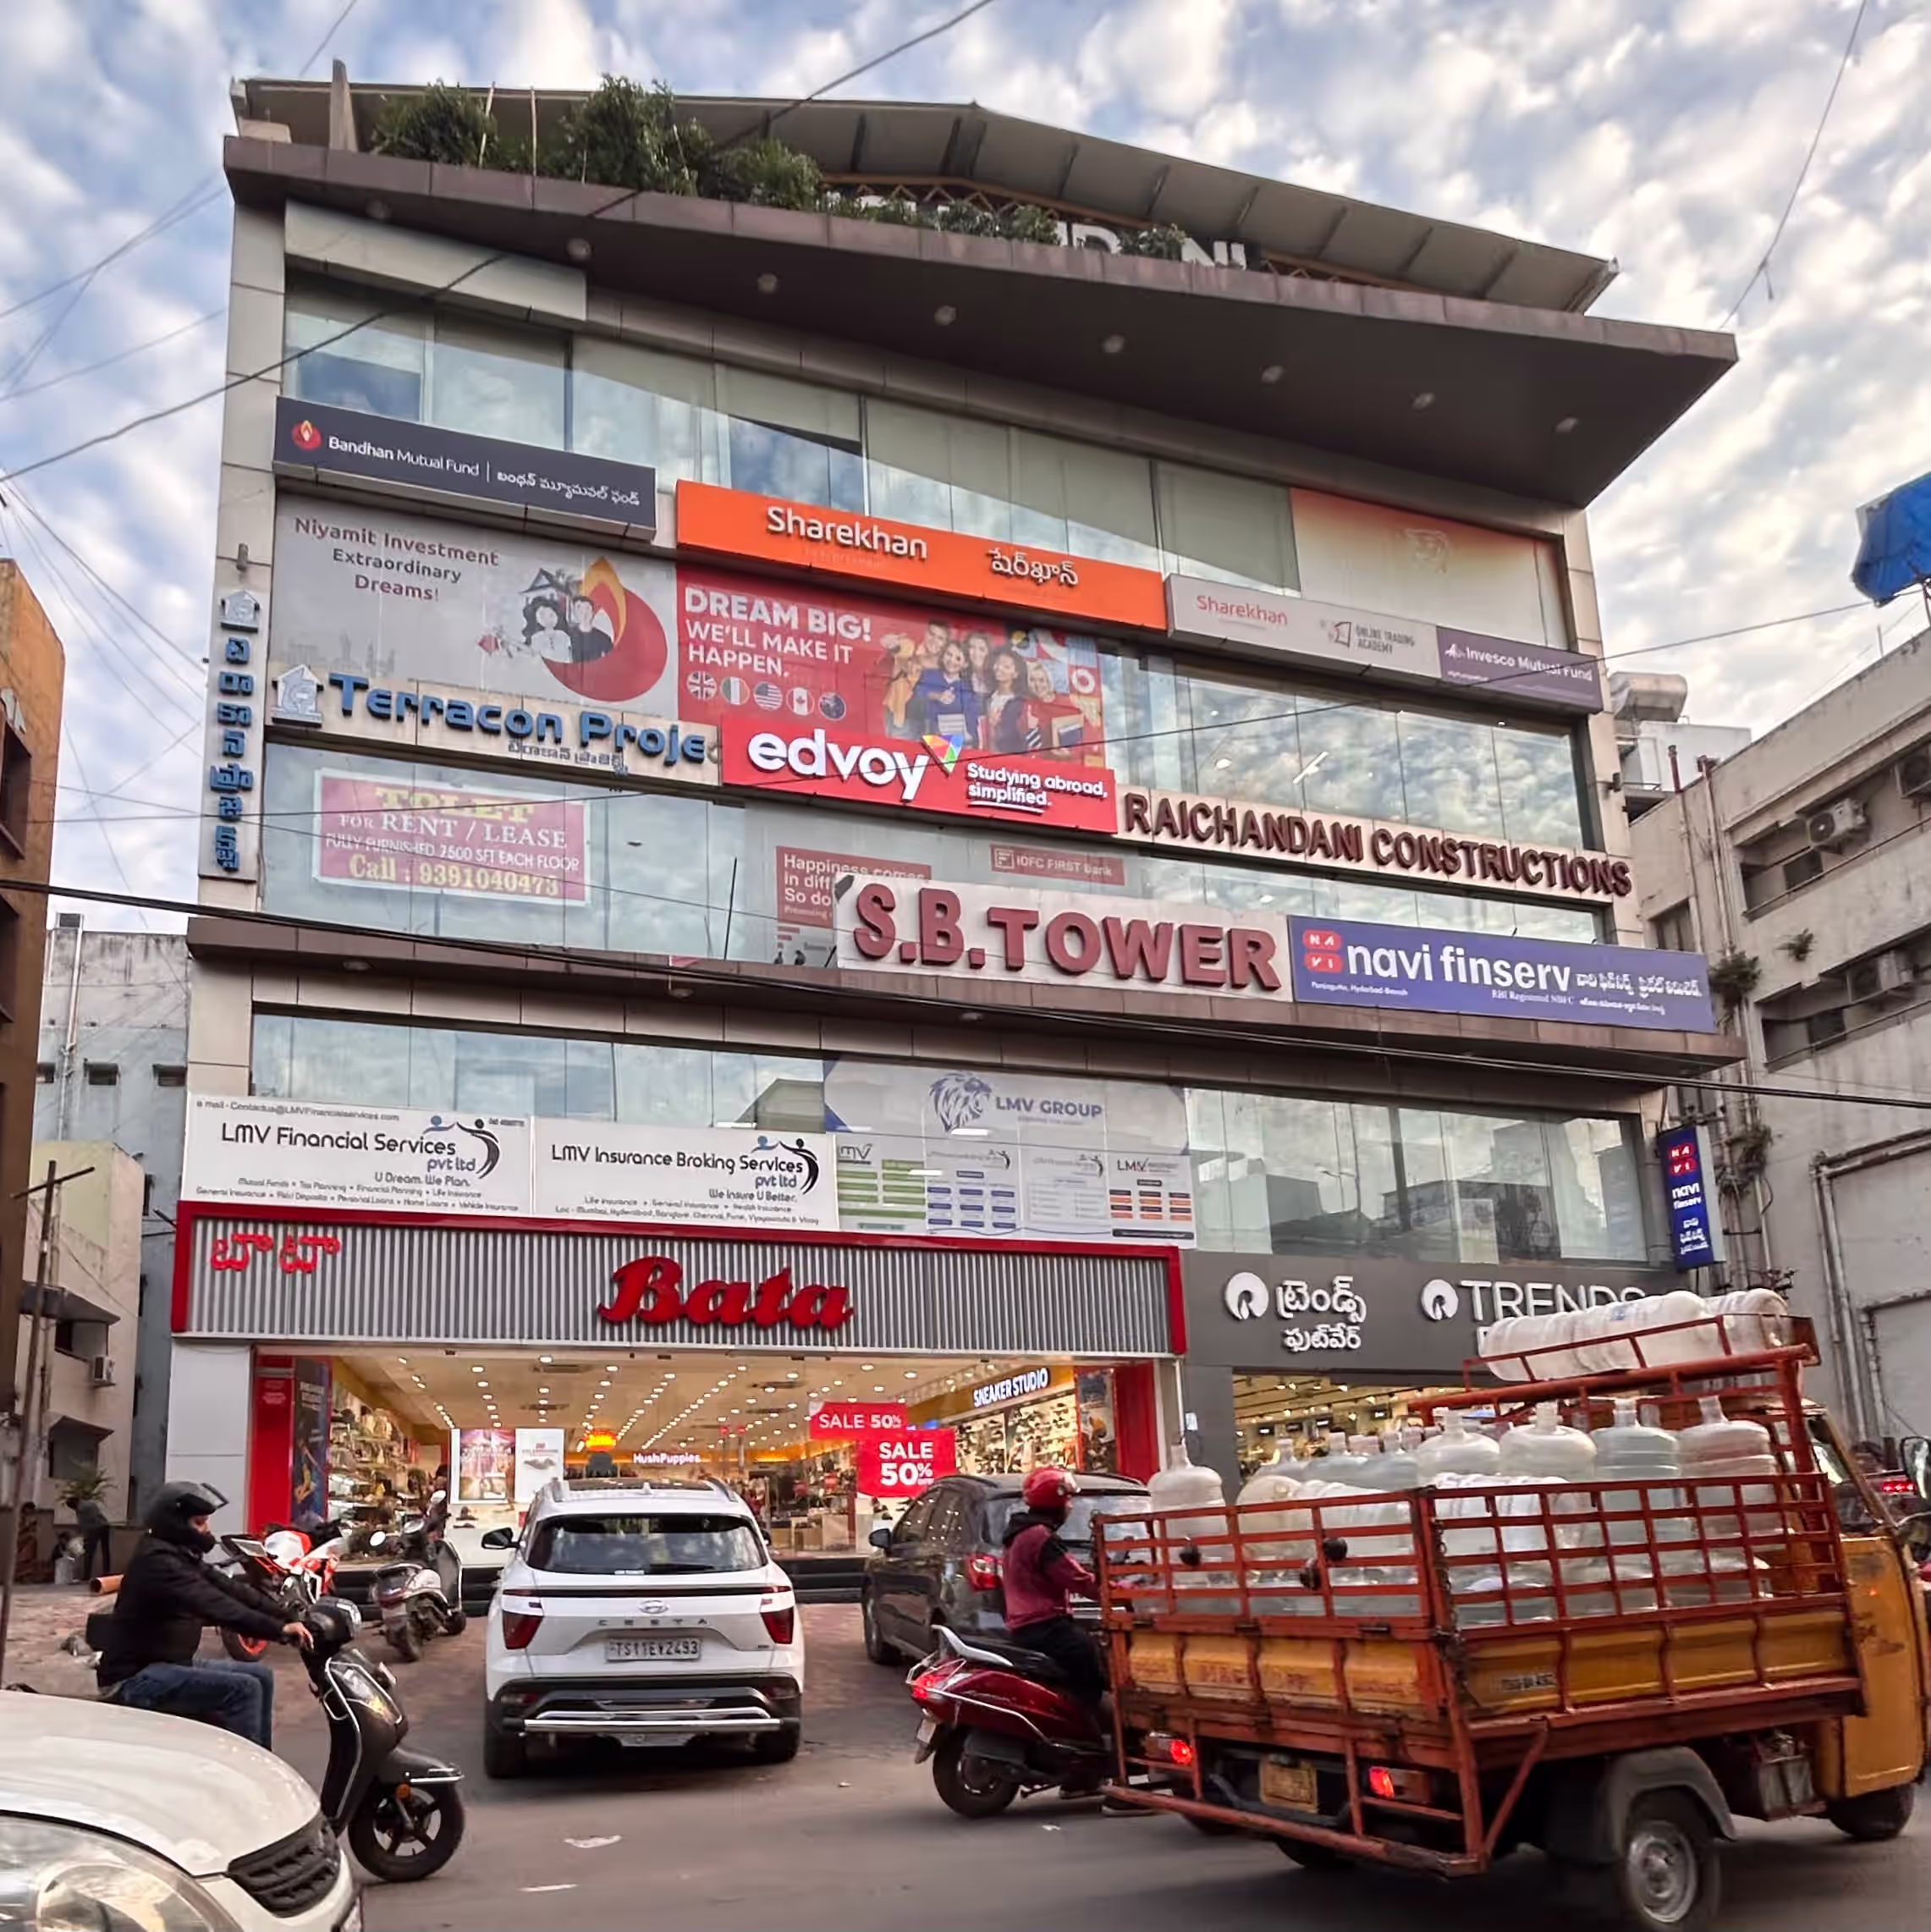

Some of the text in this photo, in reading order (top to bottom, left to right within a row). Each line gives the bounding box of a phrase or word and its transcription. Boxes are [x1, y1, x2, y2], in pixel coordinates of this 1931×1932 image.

[328, 435, 480, 476] Bandhan Mutual Fund
[294, 517, 499, 567] Niyamit Investment
[767, 506, 927, 560] Sharekhan
[333, 548, 461, 584] Extraordinary
[355, 574, 440, 602] Dreams!
[684, 587, 872, 642] DREAM BIG!
[1196, 594, 1288, 625] Sharekhan
[687, 648, 789, 678] HAPPEN.
[762, 633, 828, 658] MAKE
[832, 645, 854, 665] IT
[1466, 646, 1593, 682] Invesco Mutual Fund
[328, 672, 563, 745] Terracon
[748, 729, 931, 804] edvoy
[967, 762, 1042, 791] Studying
[968, 781, 1053, 806] simplified.
[339, 813, 374, 828] FOR
[381, 813, 458, 838] RENT
[484, 823, 568, 850] LEASE
[1125, 792, 1633, 898] RAICHANDANI CONSTRUCTIONS
[348, 853, 397, 883] Call
[499, 852, 533, 867] EACH
[537, 856, 580, 871] FLOOR
[784, 853, 869, 875] Happiness
[1047, 859, 1081, 872] FIRST
[784, 888, 806, 904] So
[1347, 944, 1571, 993] navi finserv
[996, 1097, 1103, 1118] LMV GROUP
[222, 1122, 457, 1156] LMV Financial Services
[426, 1157, 476, 1172] pvt ltd
[552, 1144, 803, 1175] LMV Insurance Broking Services
[375, 1172, 383, 1182] U
[755, 1175, 797, 1190] pvt ltd
[1672, 1182, 1701, 1199] navi
[726, 1190, 755, 1201] Insure
[756, 1192, 764, 1201] U
[597, 1256, 854, 1329] Bata
[1460, 1280, 1646, 1322] TREND
[973, 1368, 1048, 1407] SNEAKER STUDIO
[818, 1414, 864, 1429] SALE
[879, 1441, 933, 1459] SALE
[880, 1461, 933, 1486] 50%
